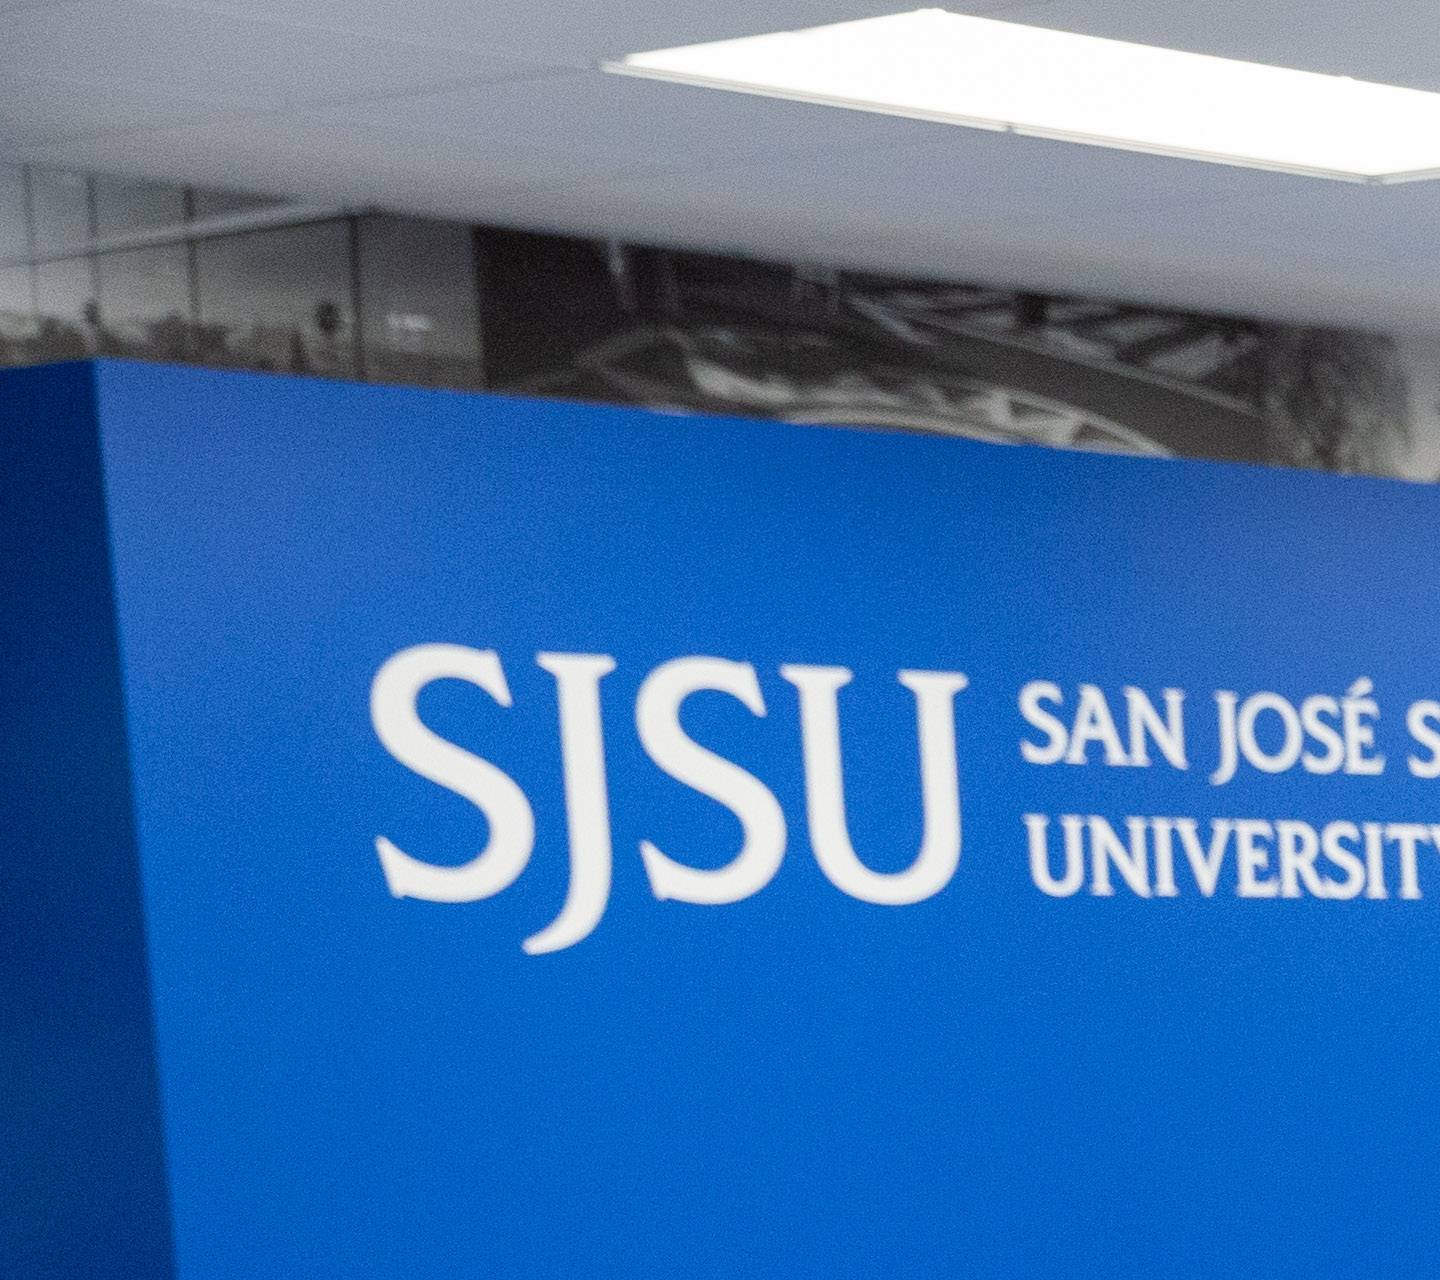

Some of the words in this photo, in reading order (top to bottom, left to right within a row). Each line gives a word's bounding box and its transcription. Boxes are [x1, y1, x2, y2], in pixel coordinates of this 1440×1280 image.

[369, 643, 968, 955] SJSU
[1018, 680, 1186, 770] SAN
[1212, 677, 1386, 785] JOSÉ
